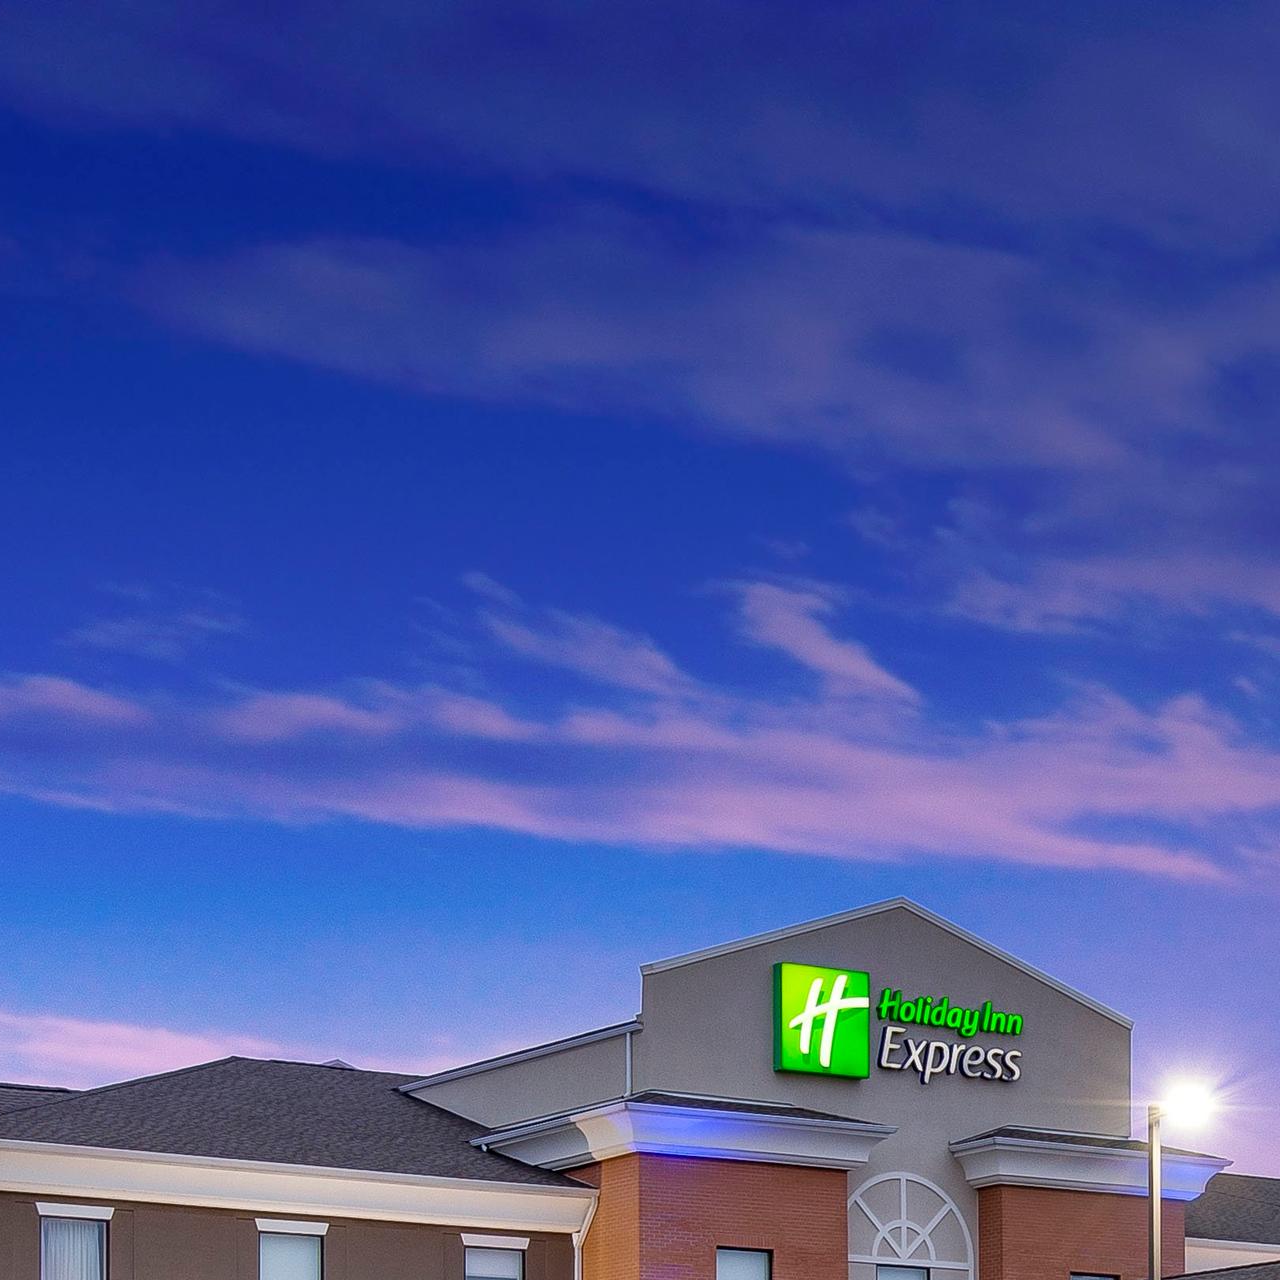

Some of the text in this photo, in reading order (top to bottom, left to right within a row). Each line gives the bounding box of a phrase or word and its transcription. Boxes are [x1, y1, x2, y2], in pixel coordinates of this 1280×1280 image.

[789, 975, 869, 1068] H
[878, 988, 1023, 1037] Holiday Inn
[879, 1026, 1023, 1084] Express
